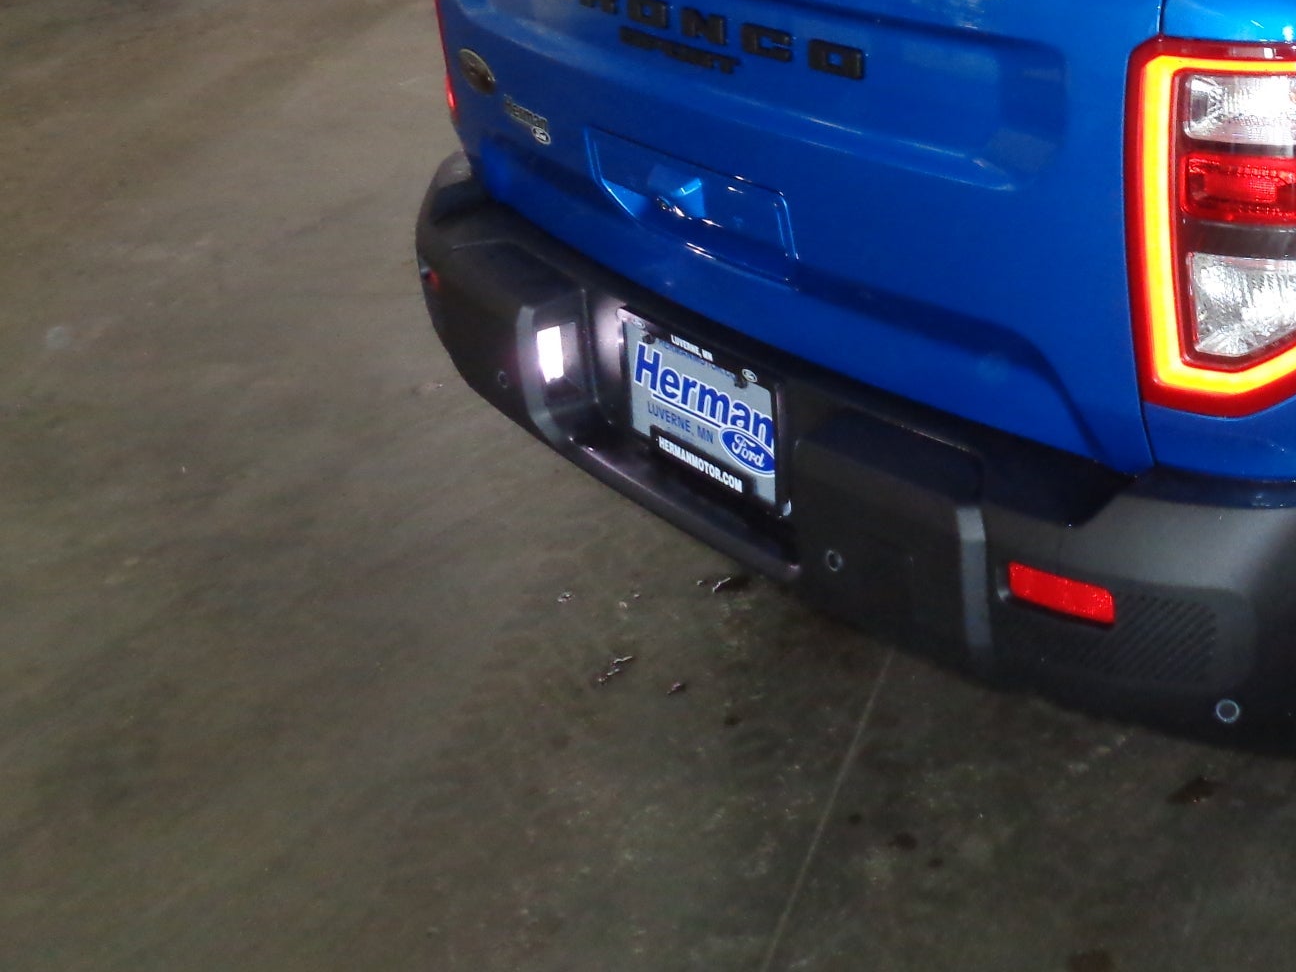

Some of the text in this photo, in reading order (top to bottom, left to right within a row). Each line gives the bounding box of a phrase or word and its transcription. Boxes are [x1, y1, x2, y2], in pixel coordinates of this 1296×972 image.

[634, 341, 774, 451] Herman
[697, 425, 714, 445] MN
[731, 432, 765, 468] Ford
